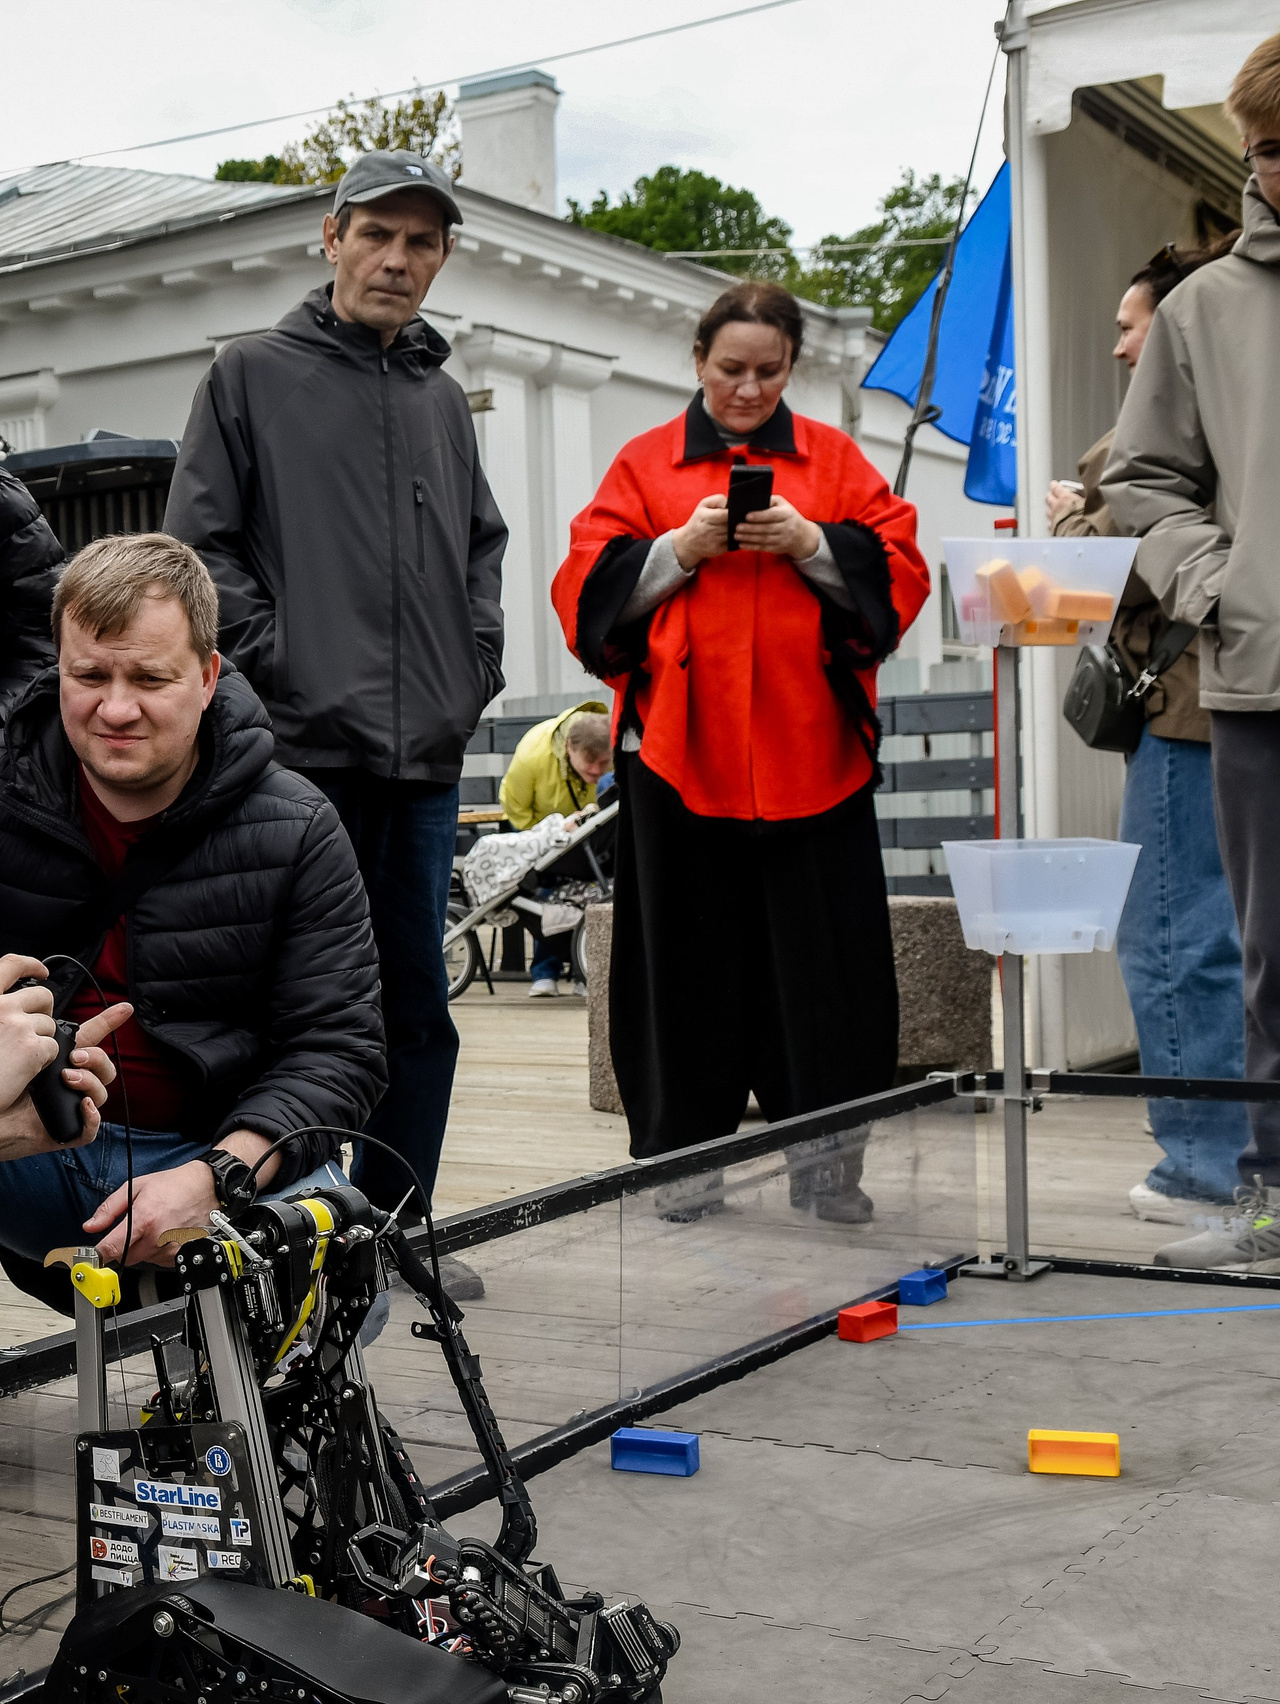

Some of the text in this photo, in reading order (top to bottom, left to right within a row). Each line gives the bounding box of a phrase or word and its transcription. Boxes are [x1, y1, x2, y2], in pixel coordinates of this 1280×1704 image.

[136, 1482, 218, 1508] StarLine
[100, 1509, 148, 1524] BESTFILAMENT
[111, 1543, 133, 1553] ДОДО
[111, 1553, 138, 1563] ПИЦЦА
